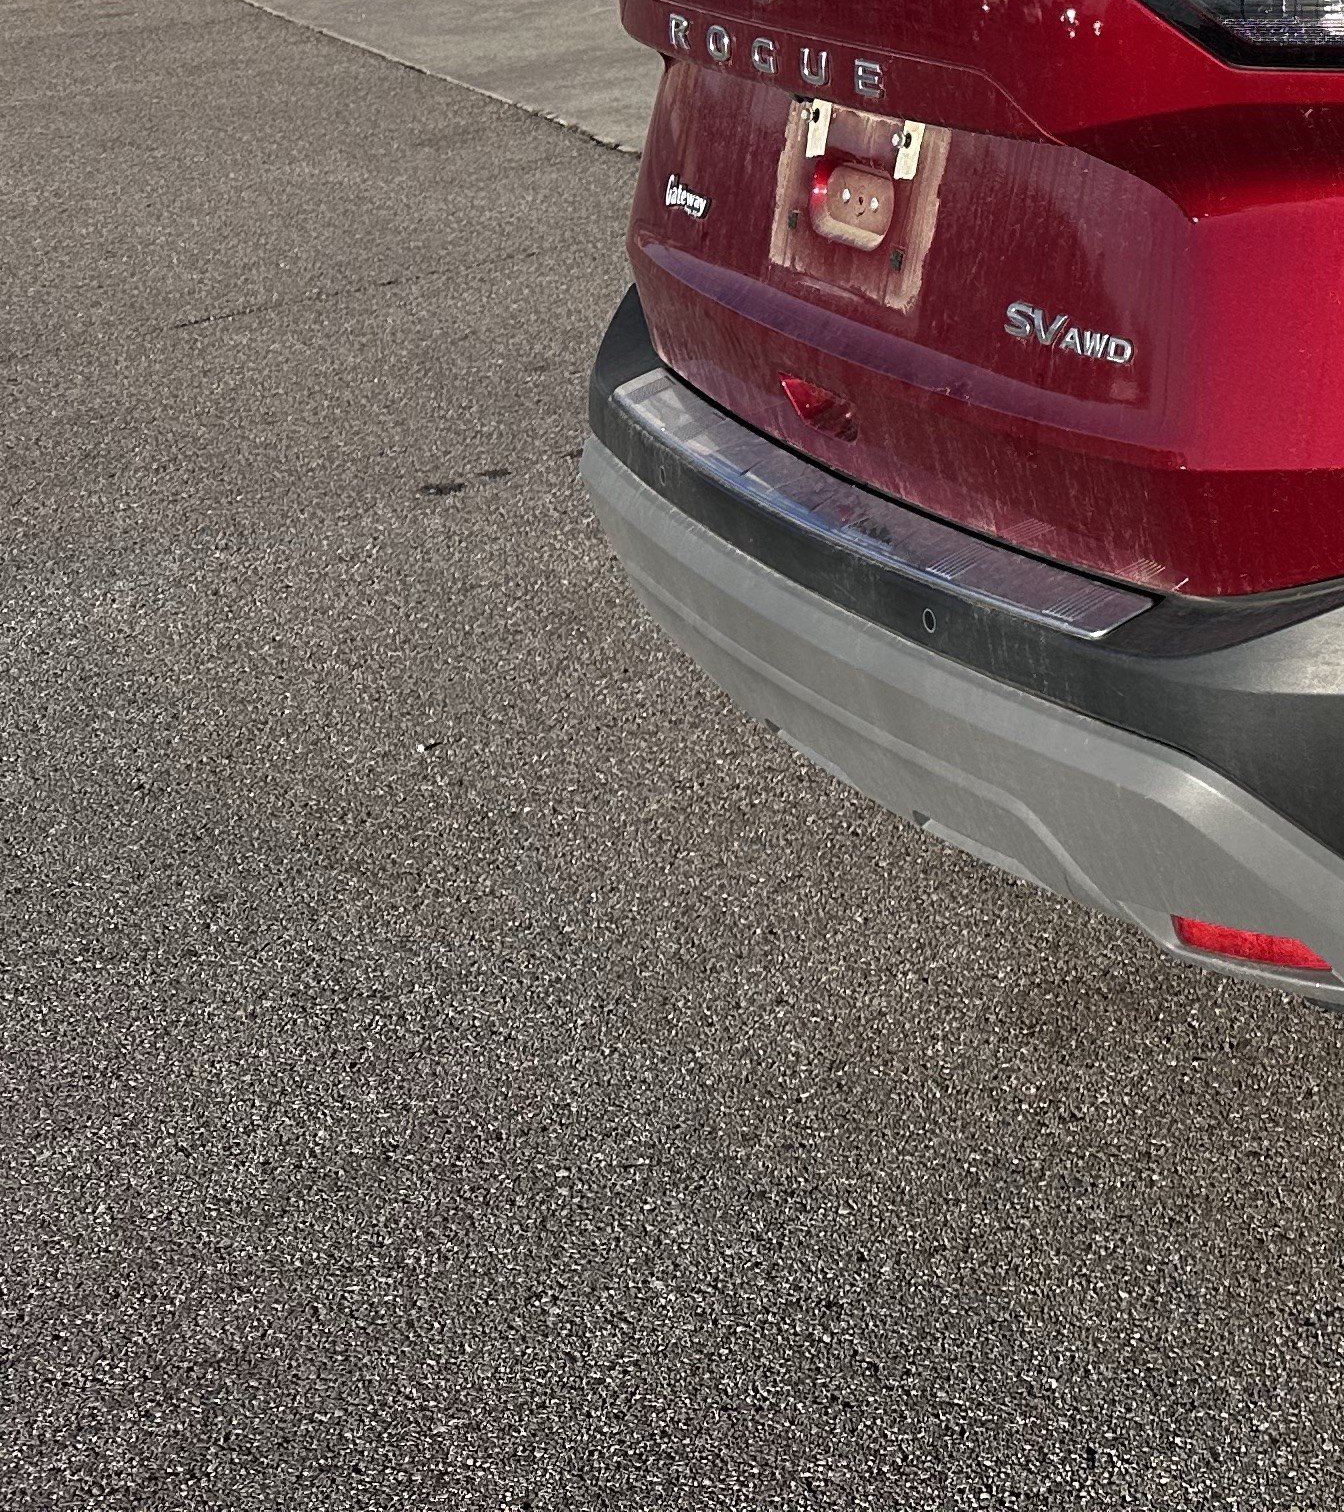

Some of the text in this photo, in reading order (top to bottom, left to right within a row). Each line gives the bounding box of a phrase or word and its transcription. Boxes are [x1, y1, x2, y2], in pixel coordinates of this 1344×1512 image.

[669, 13, 885, 98] ROGUE
[665, 174, 707, 217] Gateway
[1004, 300, 1134, 364] SV AWD
